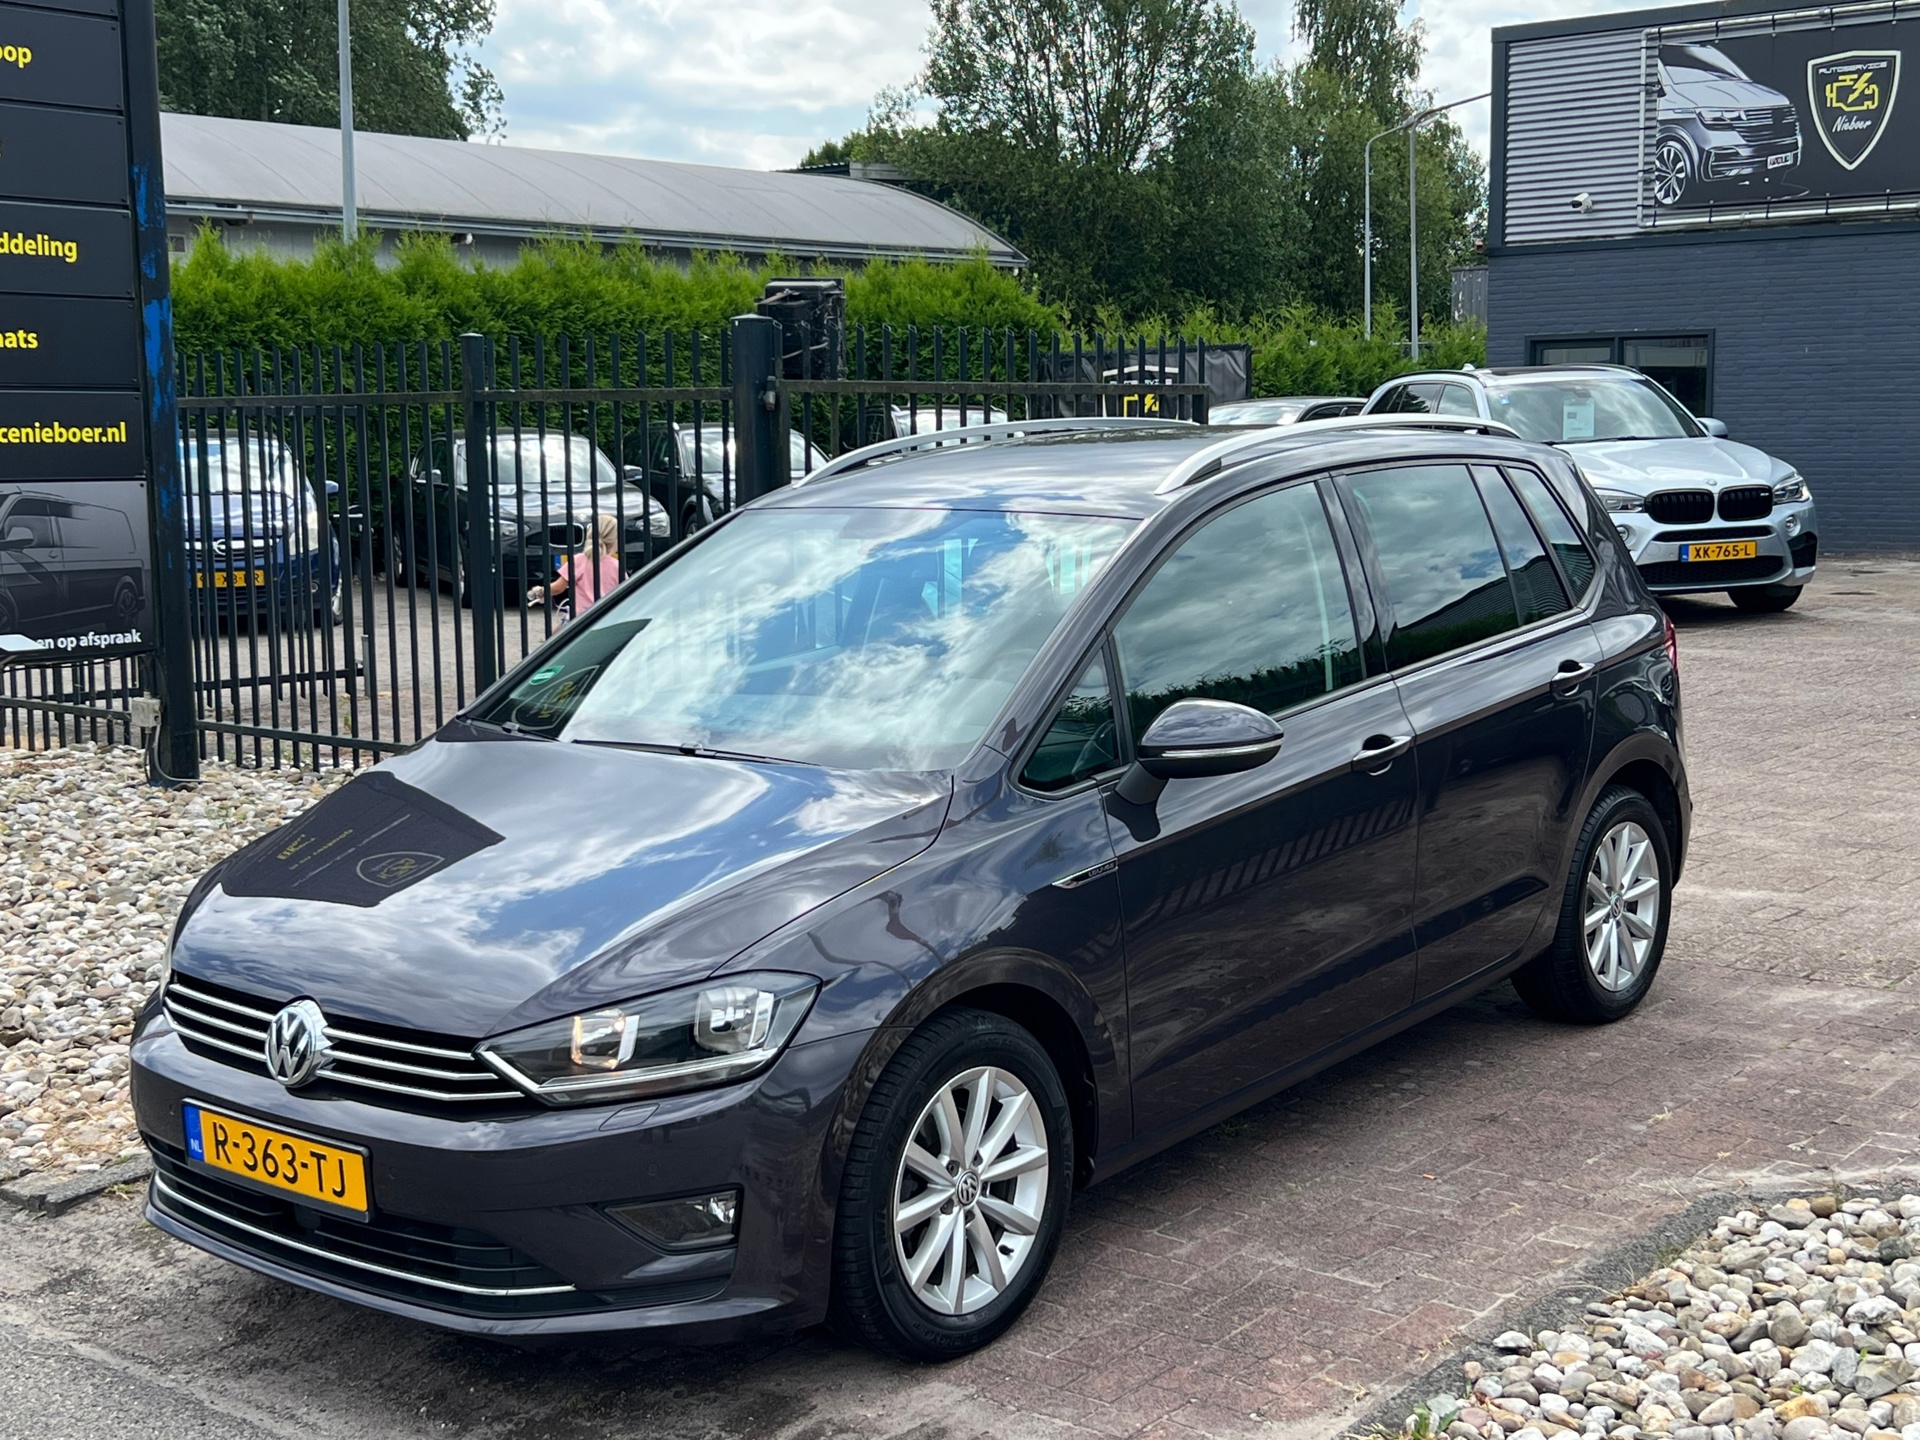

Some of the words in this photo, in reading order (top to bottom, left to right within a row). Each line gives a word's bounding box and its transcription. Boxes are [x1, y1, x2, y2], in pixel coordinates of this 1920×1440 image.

[0, 45, 32, 69] op
[1818, 61, 1888, 75] AUTOSERVICE
[1832, 114, 1873, 133] Nieboer
[1694, 544, 1752, 559] XK-765-L
[57, 636, 77, 651] op
[79, 628, 142, 649] afspraak
[190, 1138, 203, 1153] NL
[212, 1121, 346, 1198] R-363-TJ
